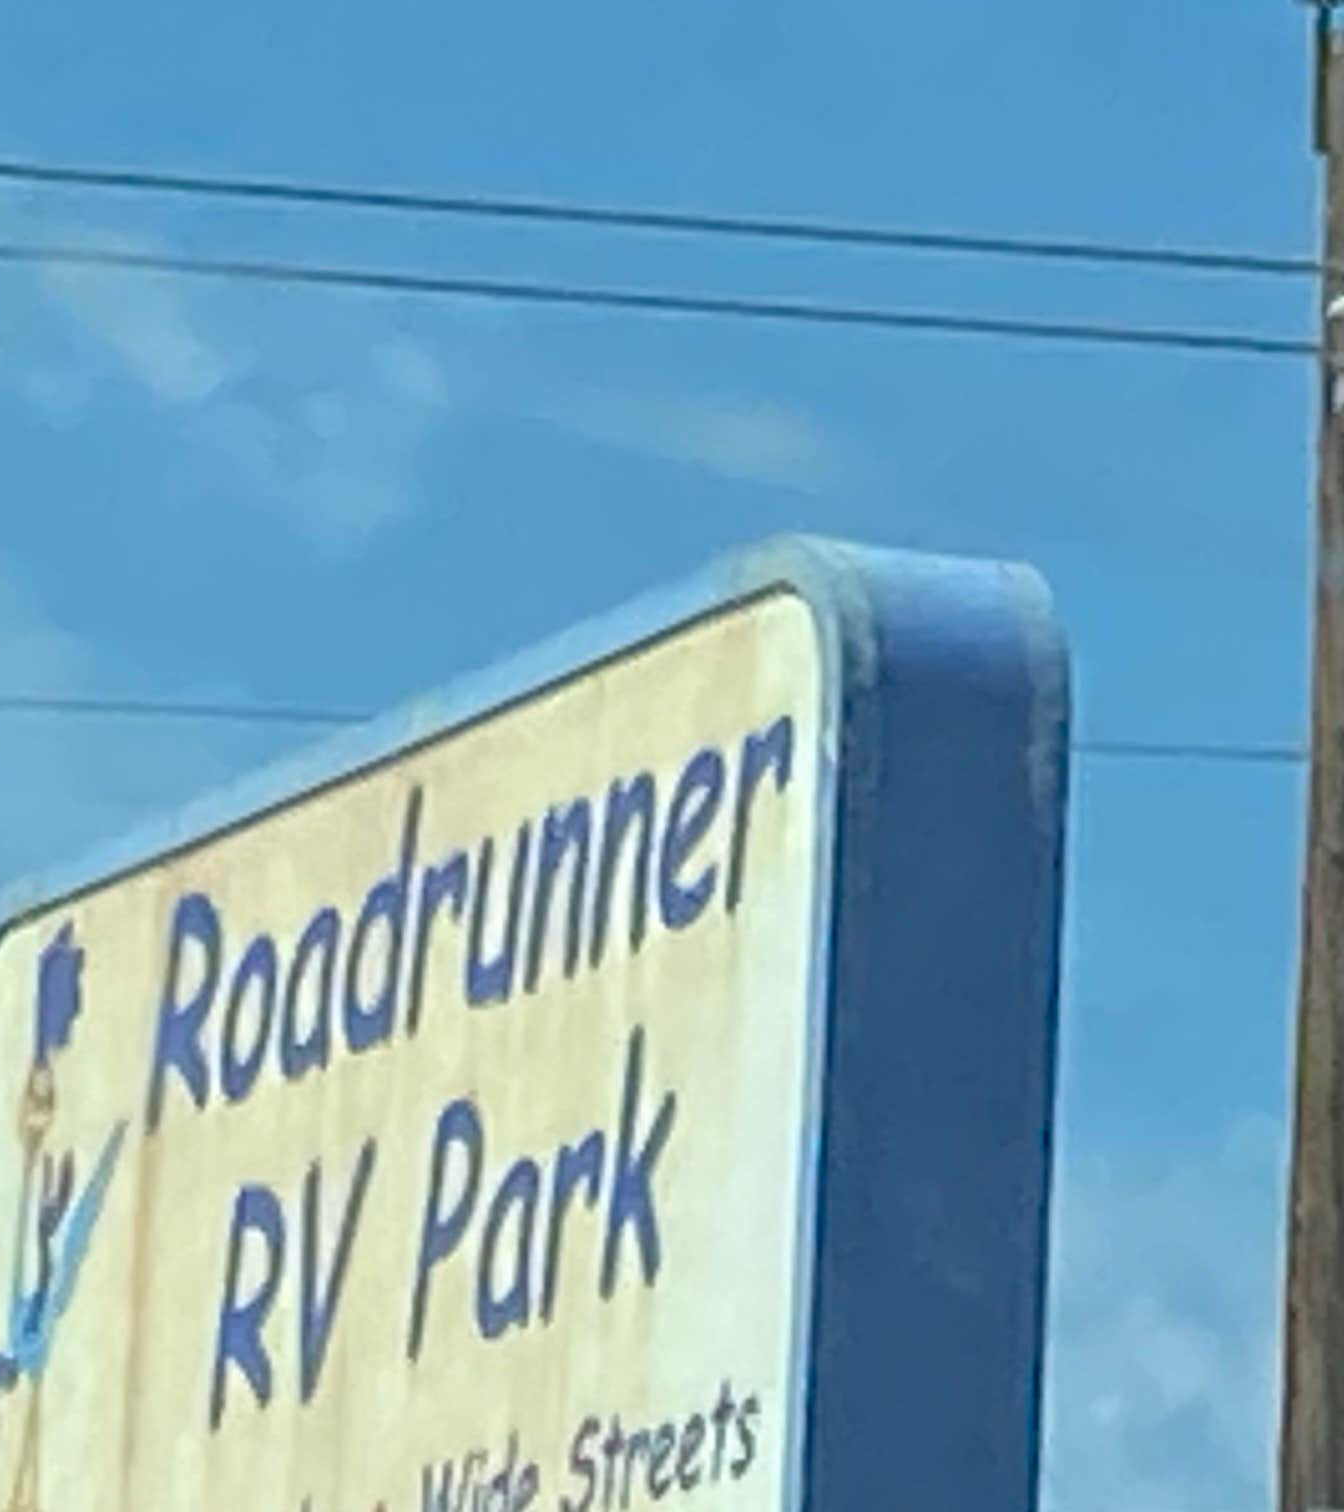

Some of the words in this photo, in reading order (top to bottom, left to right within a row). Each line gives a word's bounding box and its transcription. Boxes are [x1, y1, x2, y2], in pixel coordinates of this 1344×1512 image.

[143, 714, 797, 1136] Roadrunner
[209, 1136, 376, 1434] RV
[406, 1023, 676, 1365] Park
